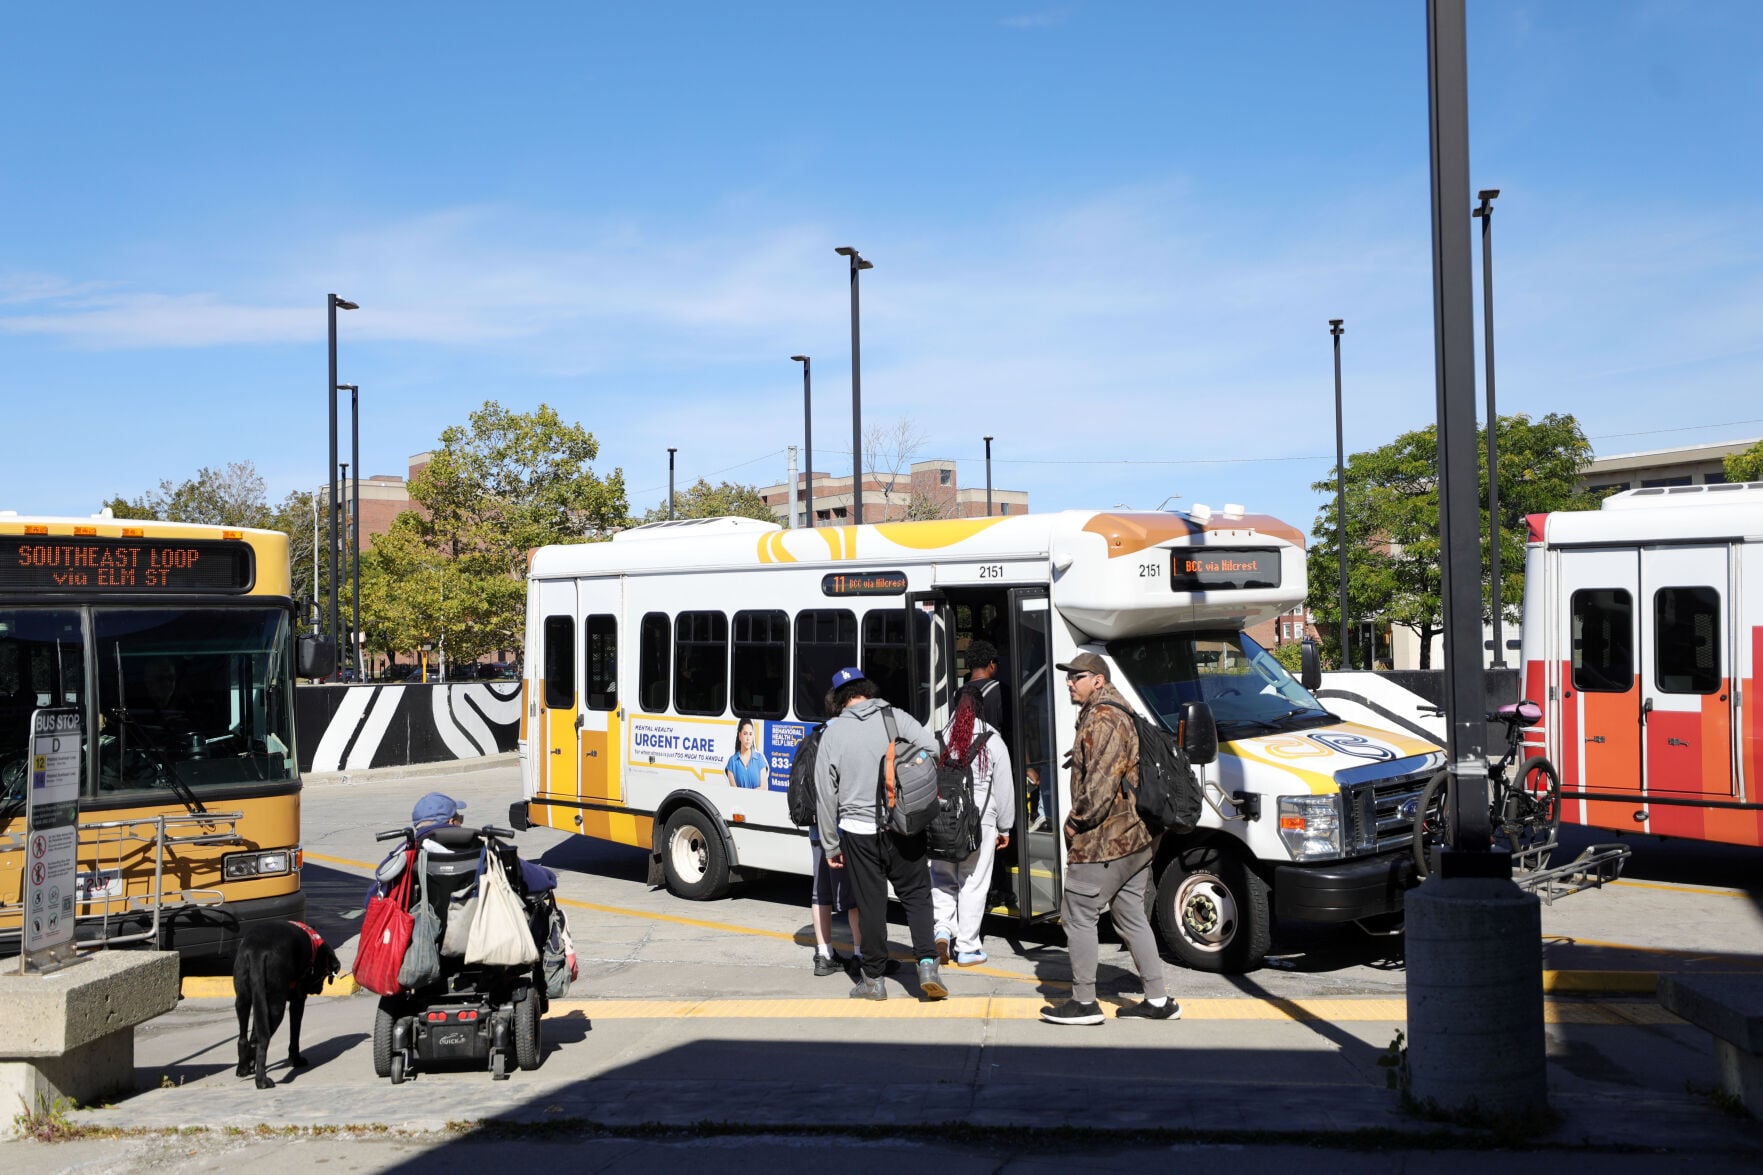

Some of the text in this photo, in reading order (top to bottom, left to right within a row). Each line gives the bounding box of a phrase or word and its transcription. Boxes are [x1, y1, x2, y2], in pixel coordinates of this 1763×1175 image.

[18, 545, 200, 568] SOUTHEAST LOOP
[979, 565, 1004, 579] 2151
[1138, 563, 1161, 578] 2151
[1205, 560, 1220, 572] via
[52, 567, 171, 587] via ELM ST
[833, 575, 845, 593] 11
[35, 713, 80, 731] BUS STOP
[52, 737, 61, 753] D
[634, 732, 715, 752] URGENT CARE
[35, 757, 45, 769] 12
